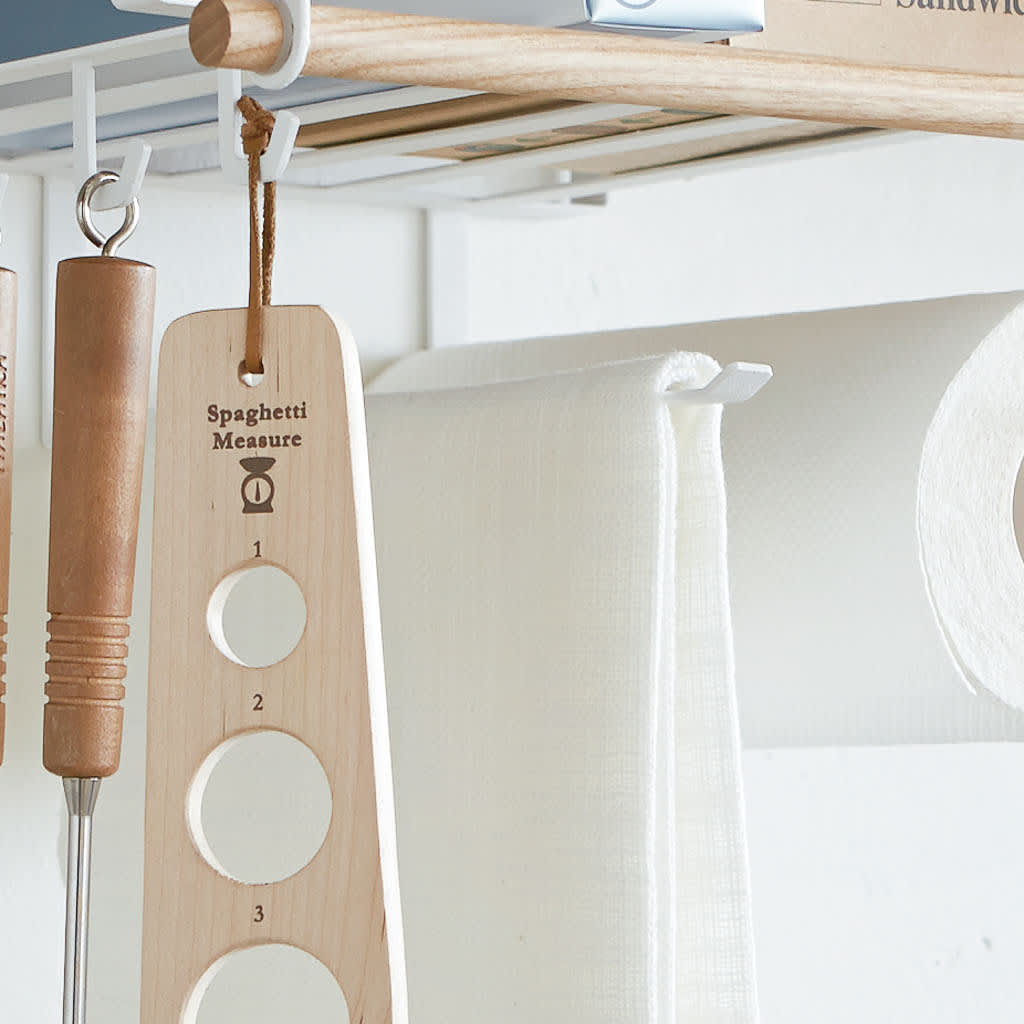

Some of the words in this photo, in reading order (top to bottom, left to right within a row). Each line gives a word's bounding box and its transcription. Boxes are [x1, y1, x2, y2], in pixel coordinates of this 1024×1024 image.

[207, 401, 308, 428] Spaghetti
[212, 431, 303, 450] Measure
[253, 540, 262, 558] 1
[252, 693, 264, 711] 2
[253, 904, 265, 923] 3
